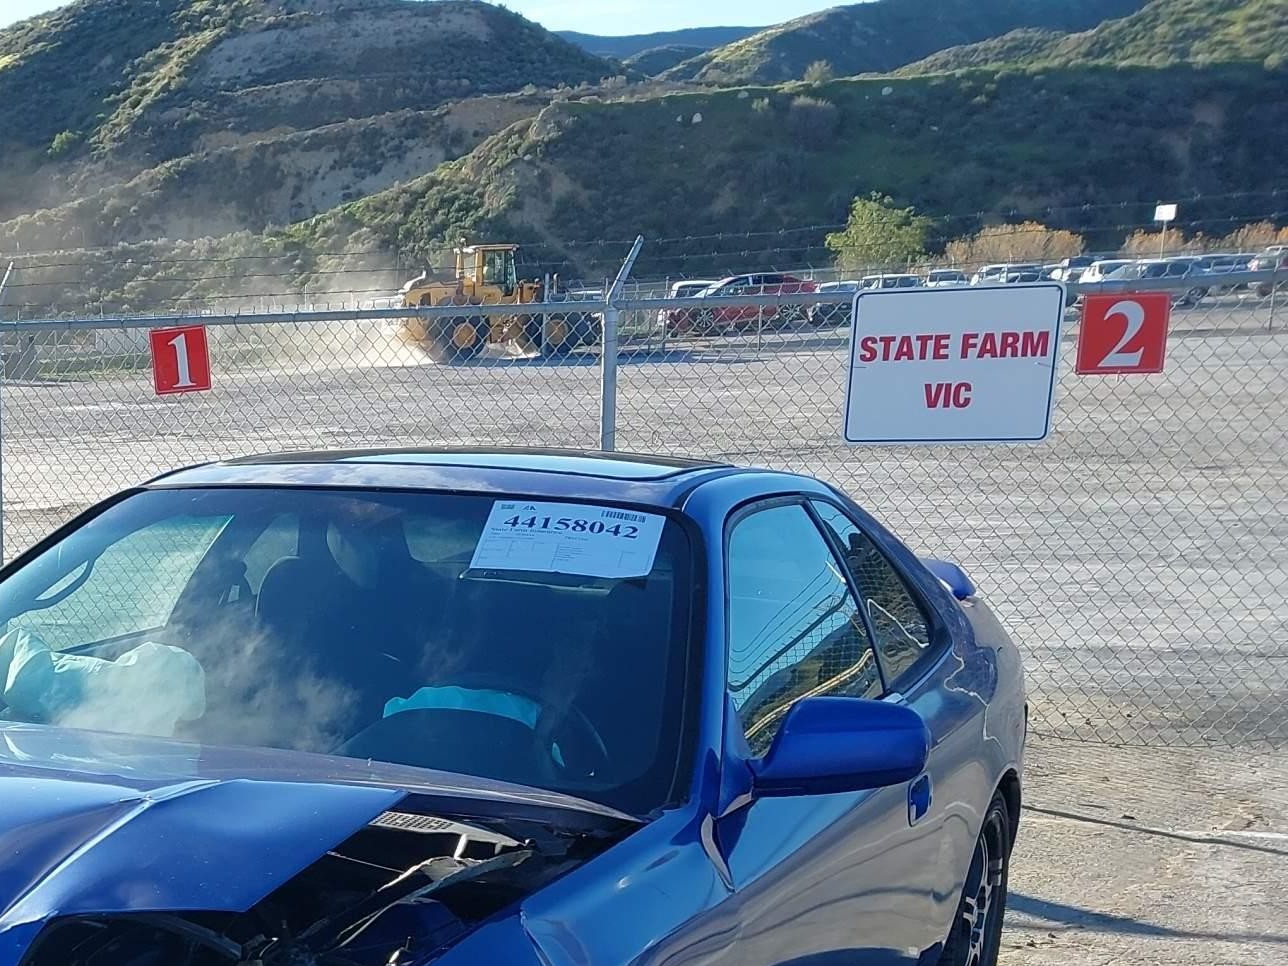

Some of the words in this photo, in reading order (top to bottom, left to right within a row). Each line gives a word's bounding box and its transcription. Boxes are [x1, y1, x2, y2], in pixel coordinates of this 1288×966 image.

[859, 334, 951, 362] STATE
[960, 331, 1049, 359] FARM
[1097, 300, 1145, 368] 2
[168, 332, 197, 388] 1
[924, 382, 972, 409] VIC
[503, 515, 638, 538] 44158042
